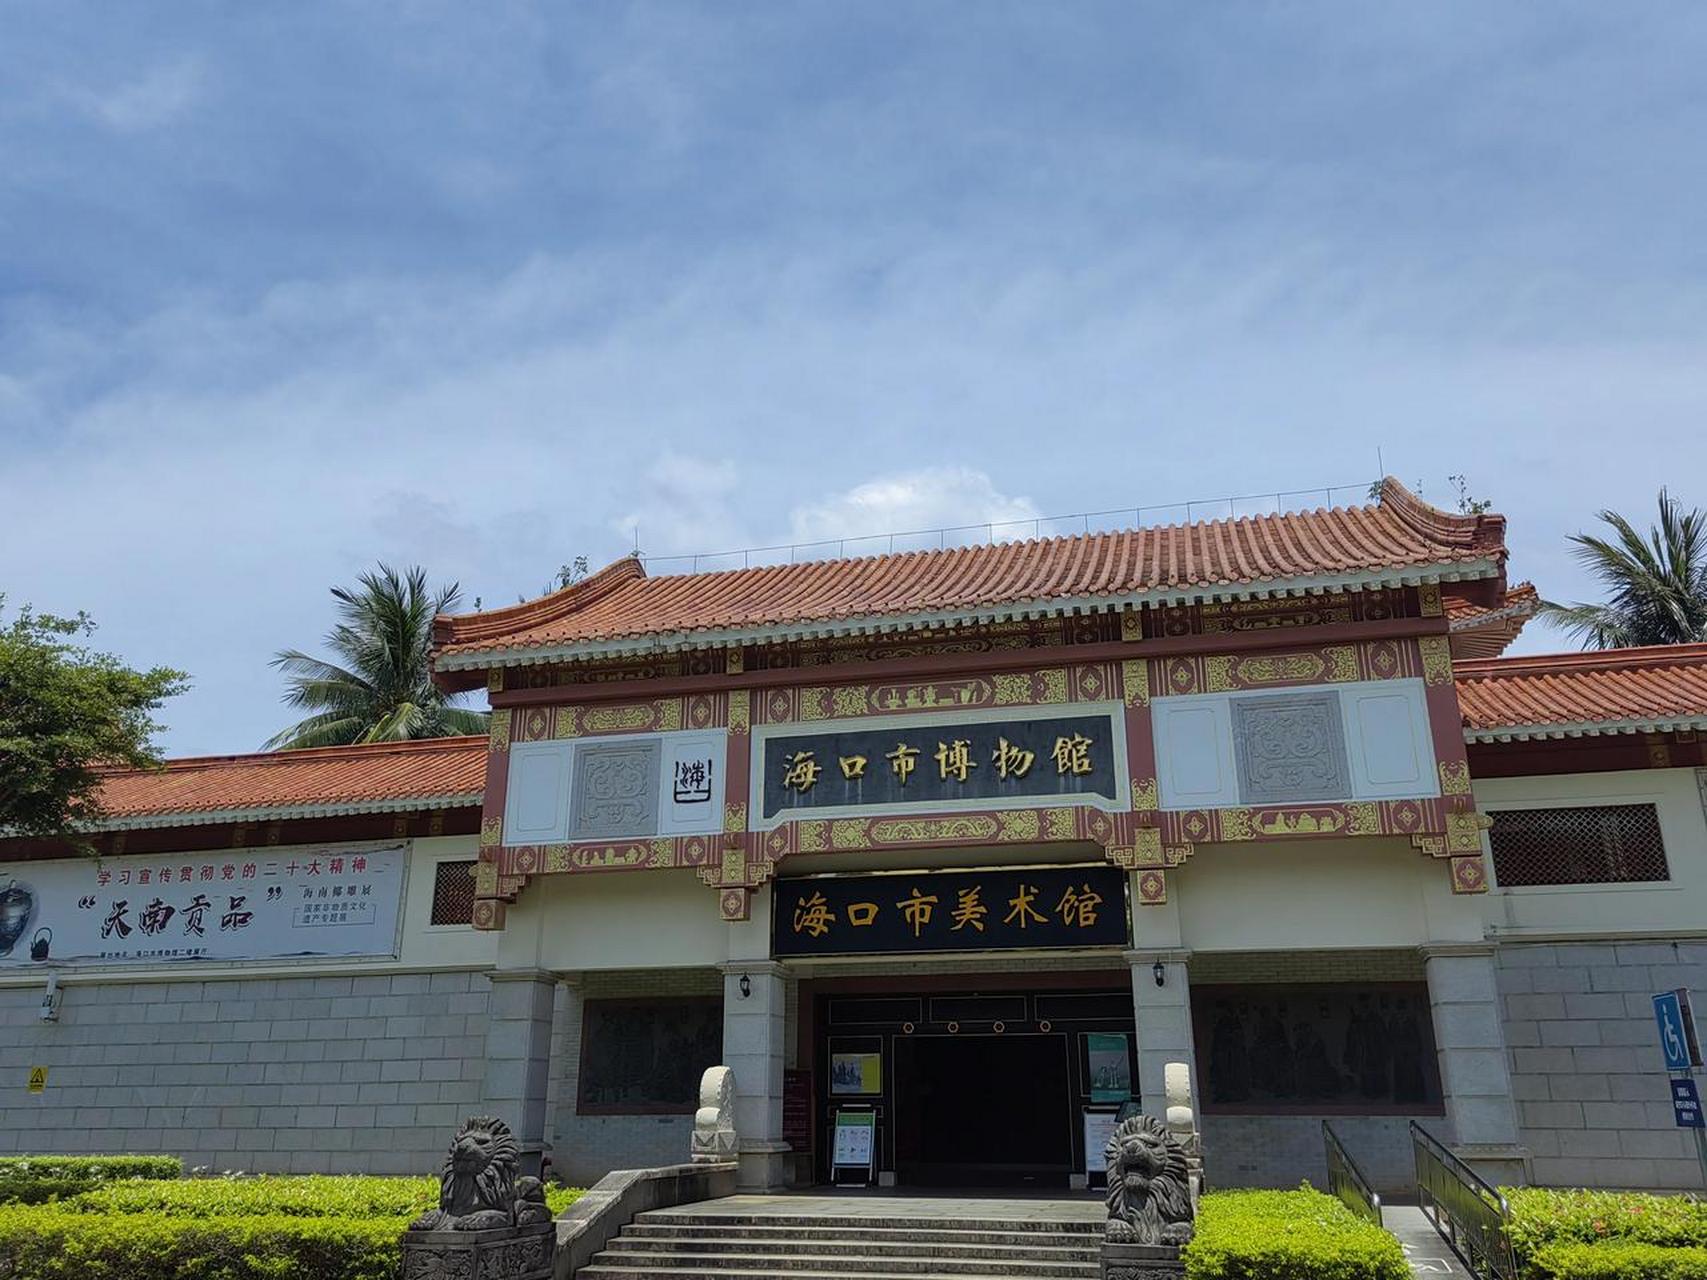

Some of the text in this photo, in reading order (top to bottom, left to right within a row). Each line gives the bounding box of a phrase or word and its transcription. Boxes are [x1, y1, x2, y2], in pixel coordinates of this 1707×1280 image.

[97, 857, 368, 886] 学习宣传贯彻党的二十大精神
[793, 883, 1105, 937] 海口市美术馆
